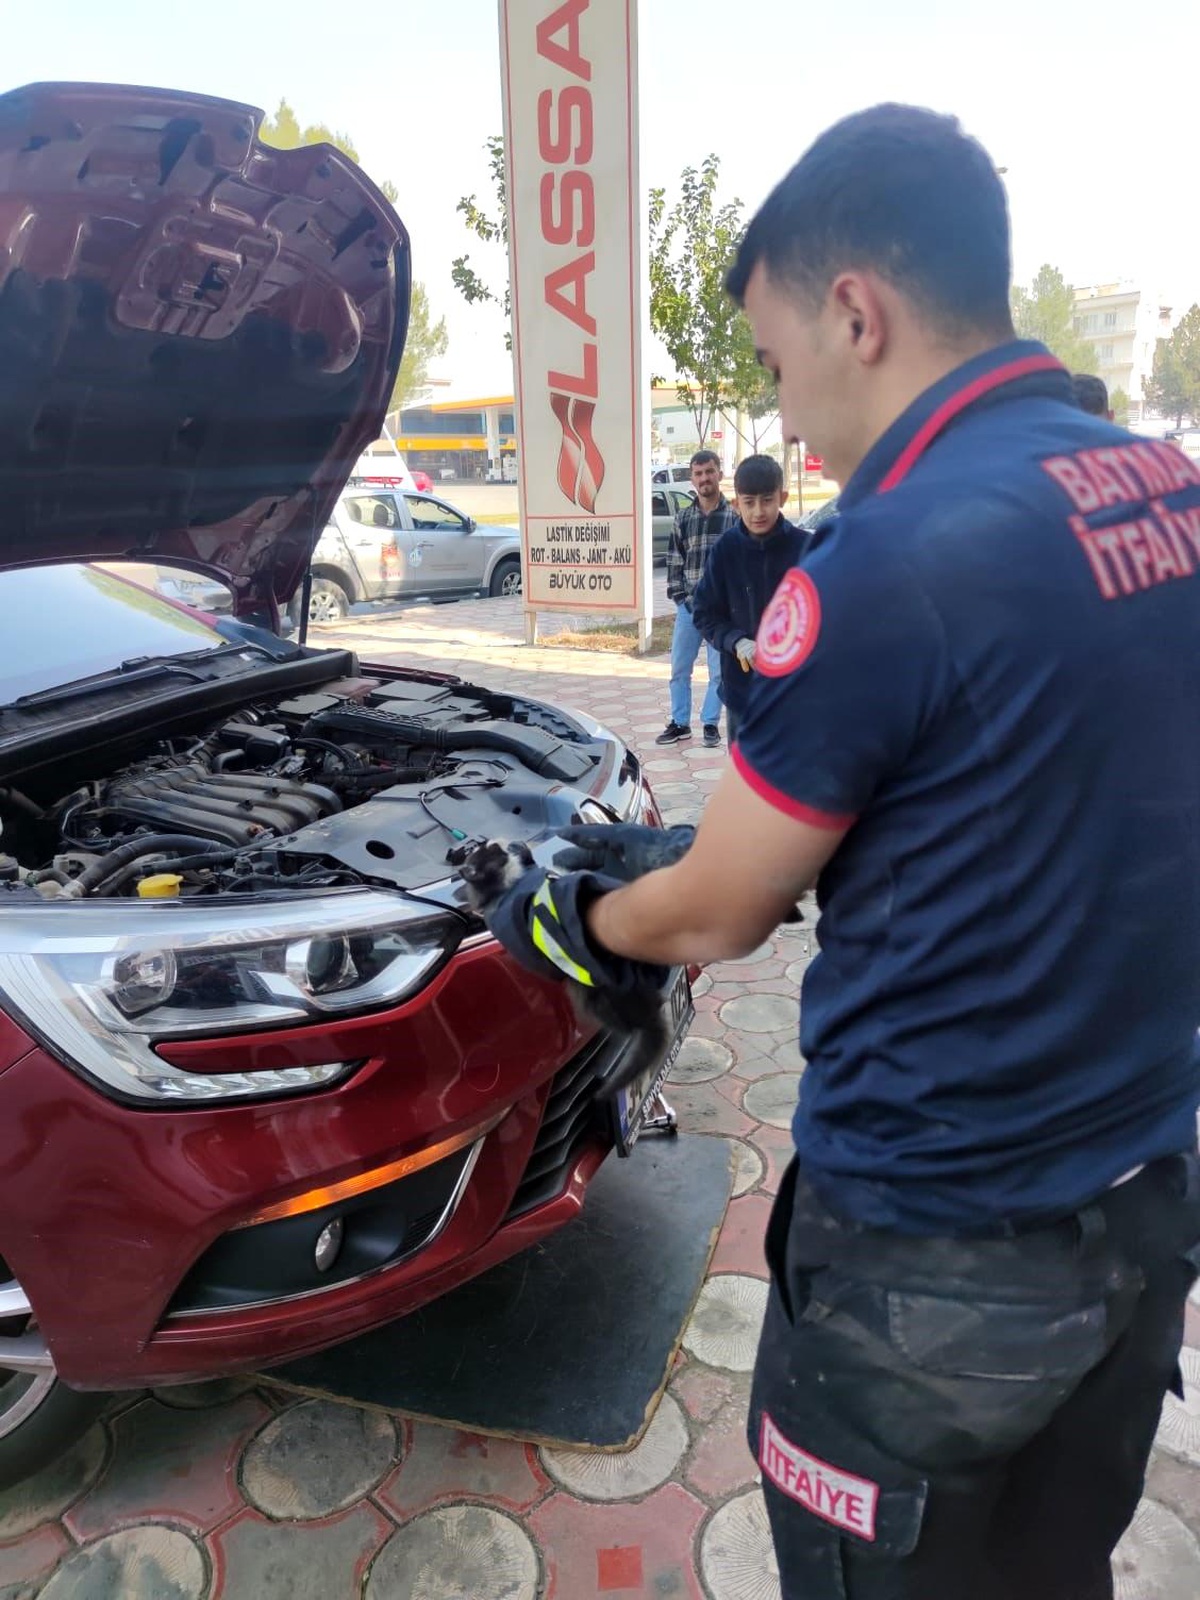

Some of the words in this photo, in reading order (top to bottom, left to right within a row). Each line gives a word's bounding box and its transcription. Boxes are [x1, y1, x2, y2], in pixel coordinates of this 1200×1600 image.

[536, 0, 600, 401] LASSA
[546, 523, 573, 543] LASTİK
[575, 522, 610, 546] DEĞİŞİMİ
[531, 548, 546, 563] ROT
[551, 548, 581, 564] BALANS
[586, 548, 607, 564] JANT
[613, 545, 631, 564] AKÜ
[549, 570, 585, 590] BÜYÜK
[588, 574, 612, 591] OTO
[766, 1430, 863, 1526] İTFAİYE
